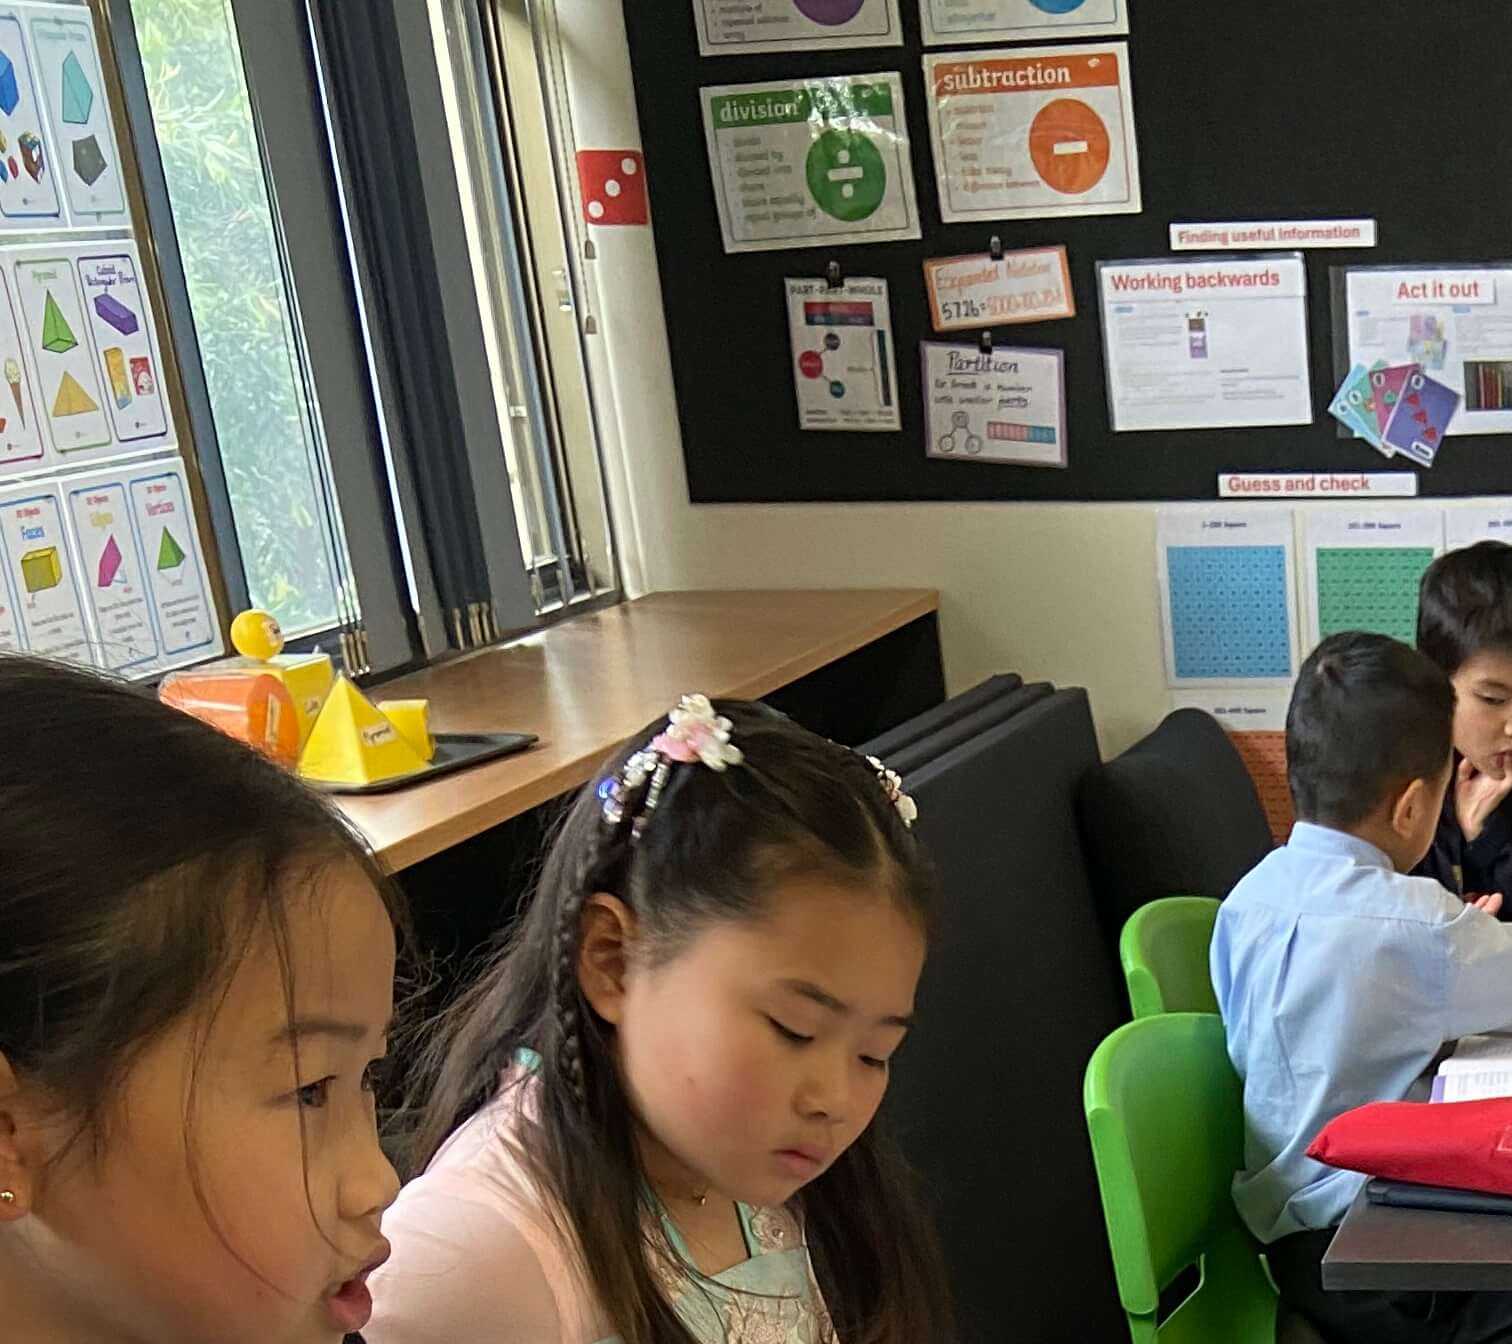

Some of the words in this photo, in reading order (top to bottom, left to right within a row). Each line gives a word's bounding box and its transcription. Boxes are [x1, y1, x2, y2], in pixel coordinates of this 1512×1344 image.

[944, 63, 1071, 90] subtraction
[720, 98, 798, 121] division
[1178, 230, 1229, 247] Finding
[1232, 227, 1275, 243] useful
[1278, 225, 1360, 241] information
[1110, 273, 1183, 294] Working
[1186, 270, 1280, 288] backwards
[1397, 281, 1428, 298] Act
[1432, 281, 1444, 298] it
[1449, 280, 1479, 298] out
[947, 351, 1019, 373] Partition
[1228, 476, 1280, 493] Guess
[1285, 475, 1317, 491] and
[1320, 474, 1370, 491] check
